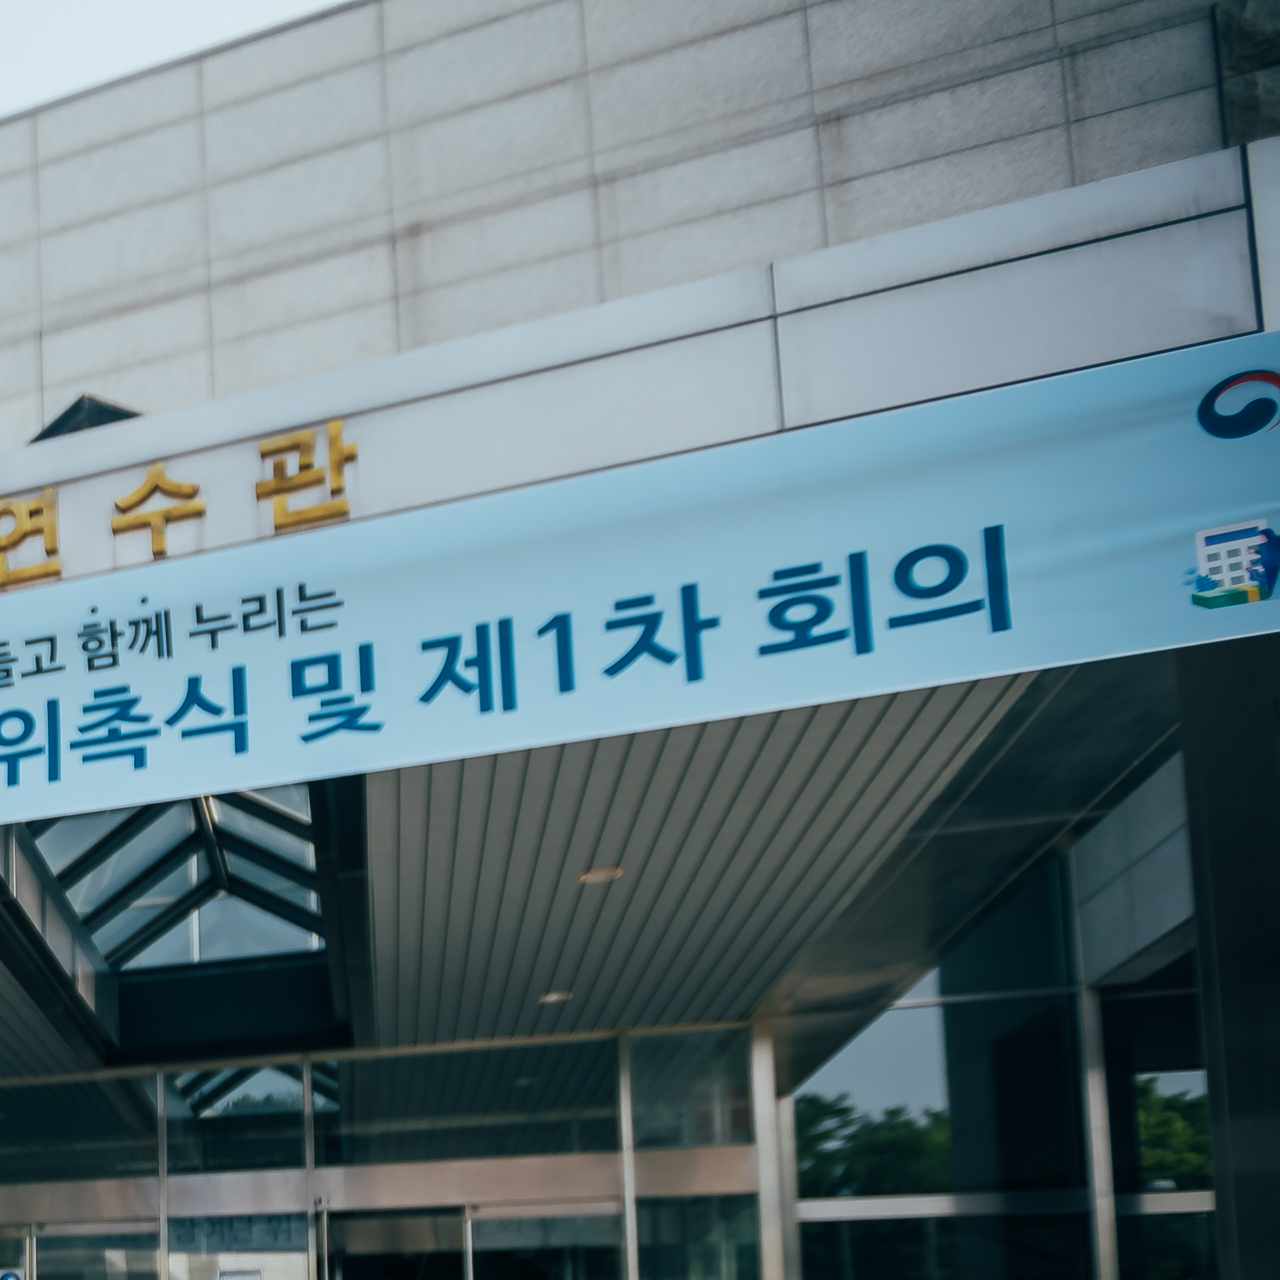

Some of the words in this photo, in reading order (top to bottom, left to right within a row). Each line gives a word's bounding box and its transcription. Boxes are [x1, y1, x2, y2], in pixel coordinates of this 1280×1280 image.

[77, 594, 174, 672] 함께
[188, 582, 344, 651] 누리는
[288, 642, 384, 744] 및
[418, 582, 721, 716] 제1차
[755, 522, 1013, 660] 회의
